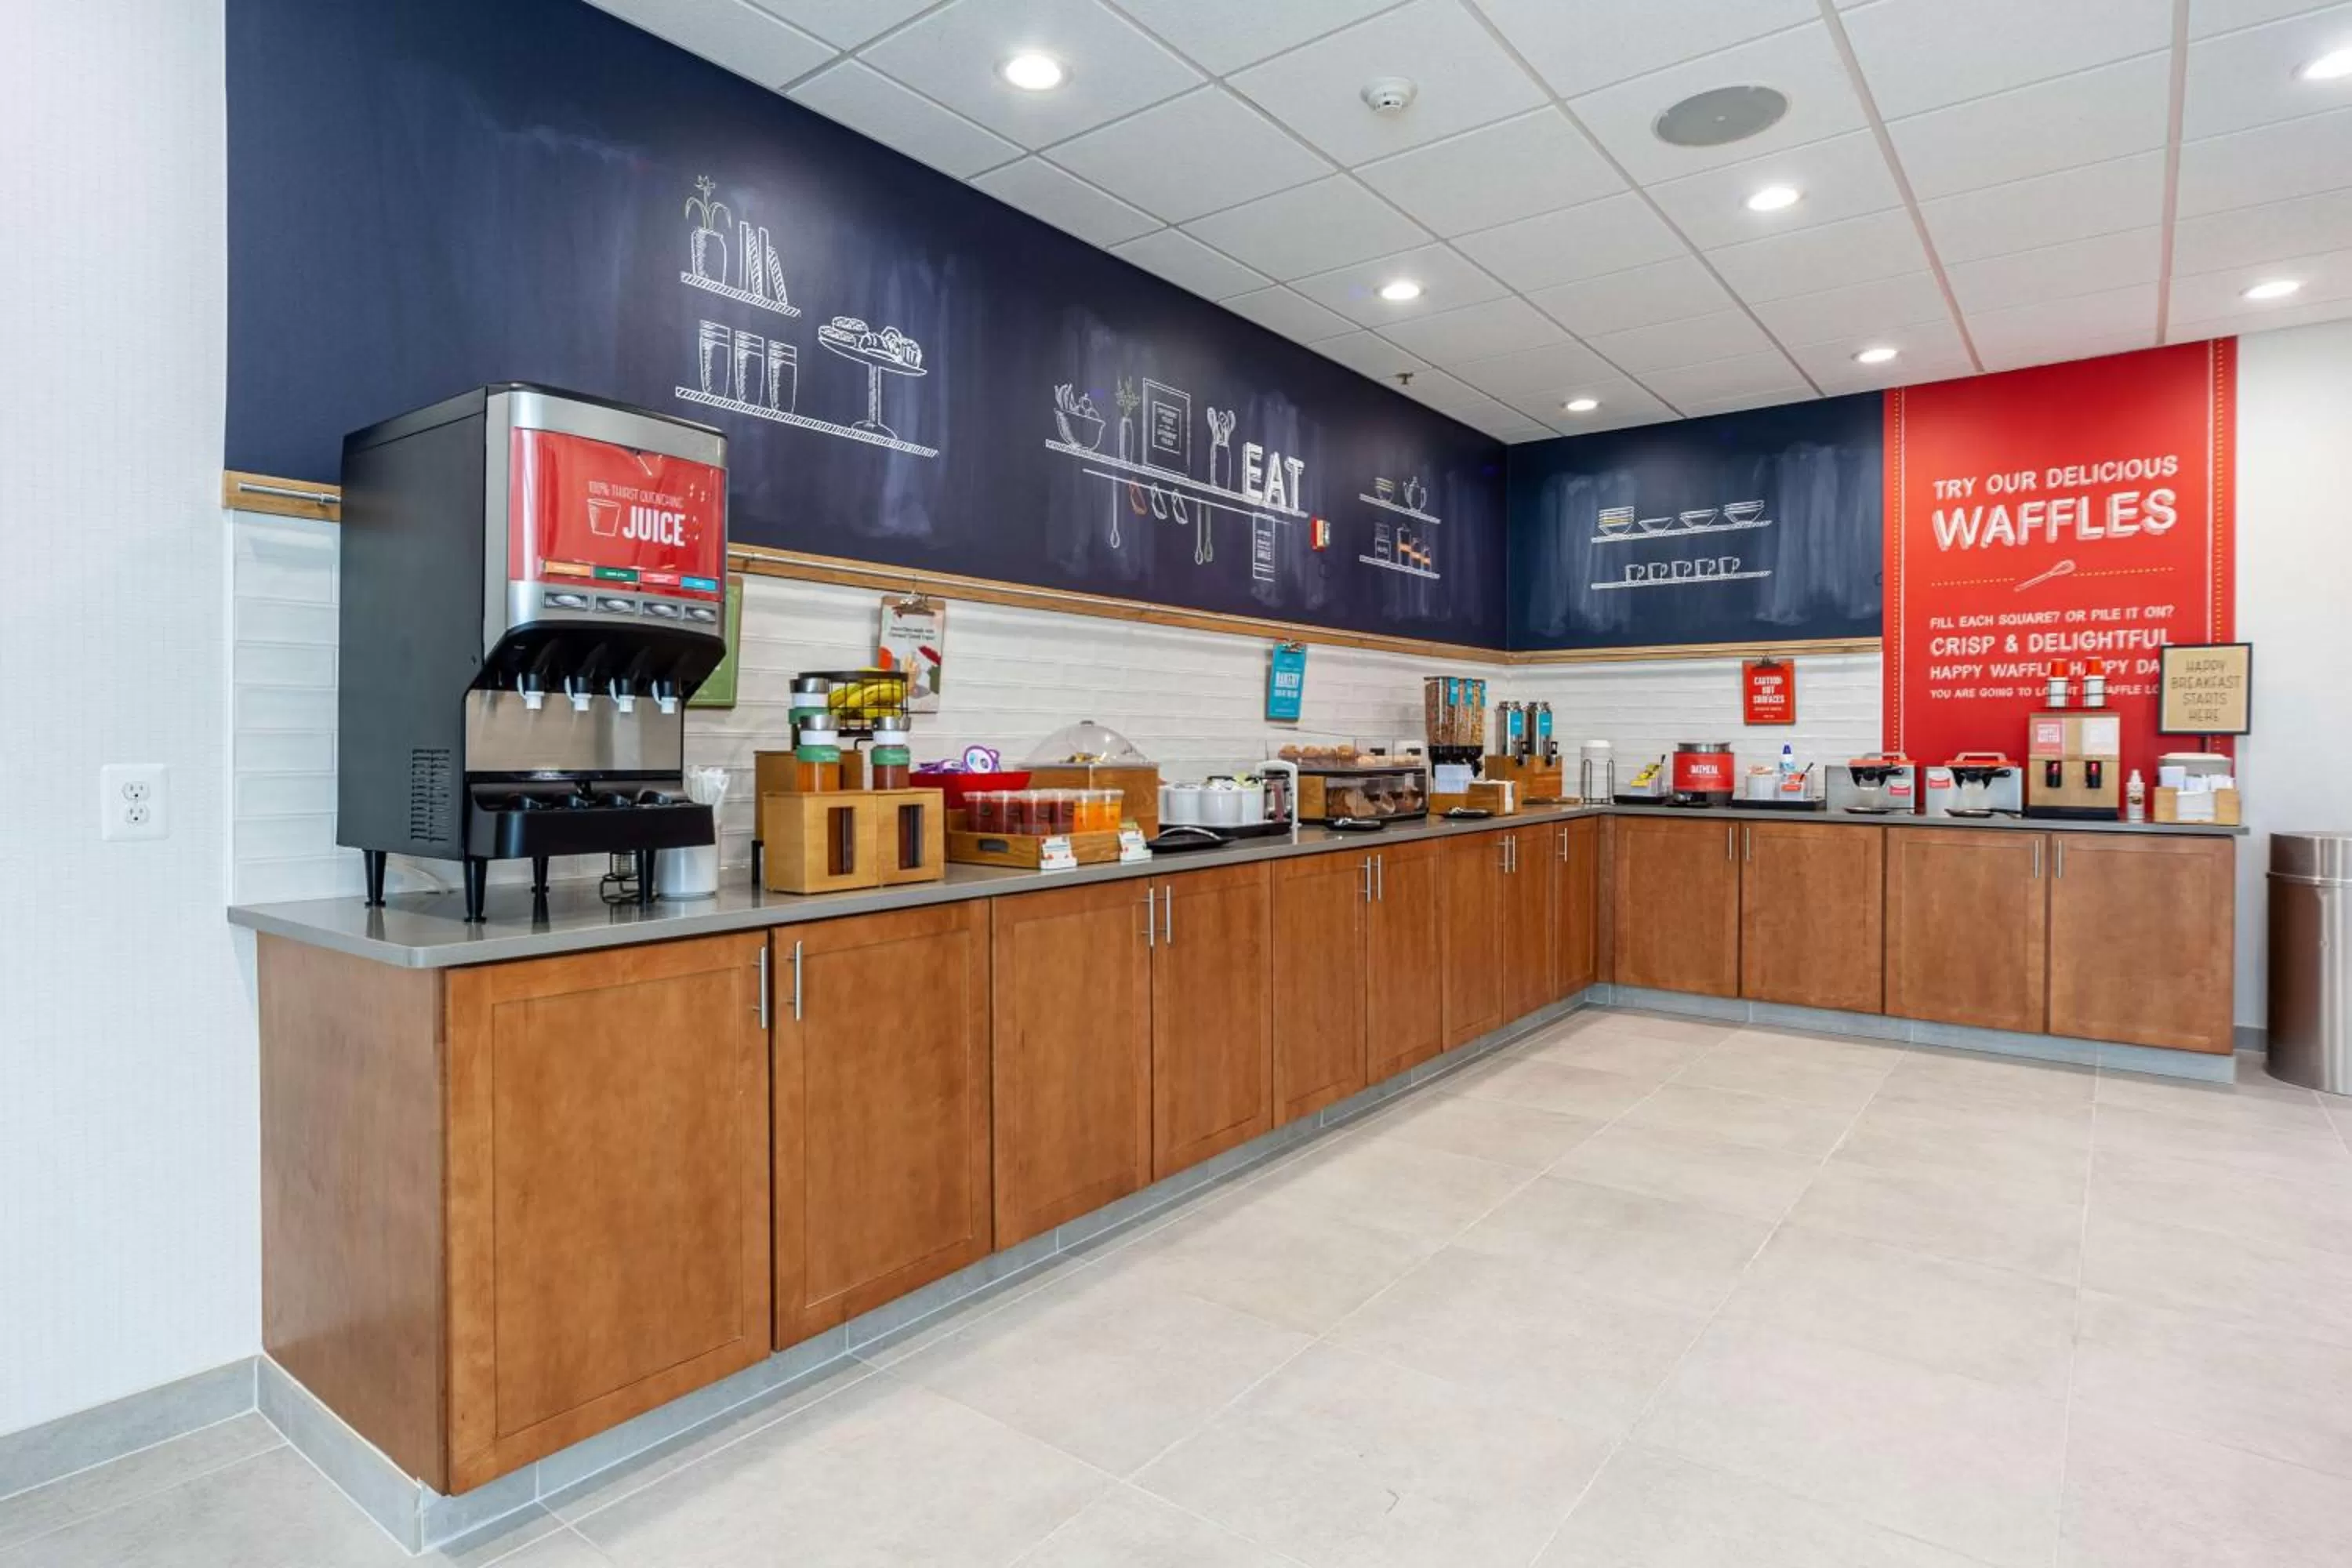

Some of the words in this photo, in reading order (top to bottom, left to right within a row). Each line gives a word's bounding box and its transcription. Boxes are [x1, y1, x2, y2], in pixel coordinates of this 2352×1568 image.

[1242, 441, 1305, 511] EAT
[1933, 477, 1977, 499] TRY
[1985, 470, 2037, 495] OUR
[2045, 455, 2178, 489] DELICIOUS
[622, 506, 686, 546] JUICE
[1931, 488, 2177, 551] WAFFLES
[1929, 617, 1955, 629] FILL
[1959, 614, 1994, 627] EACH
[1999, 611, 2060, 625] SQUARE?
[2064, 609, 2086, 622] OR
[2091, 608, 2121, 620] PILE
[2125, 607, 2140, 619] IT
[2143, 604, 2175, 619] ON?
[1929, 635, 1995, 657] CRISP
[2004, 633, 2019, 653] &
[2027, 628, 2175, 653] DELIGHTFUL
[1929, 664, 1983, 681] HAPPY
[2069, 659, 2129, 675] HPY
[2136, 658, 2160, 674] DA
[2185, 659, 2226, 673] HAPPY
[1929, 688, 1951, 699] YOU
[1955, 688, 1976, 698] ARE
[1980, 687, 2013, 697] GOING
[2017, 687, 2032, 696] TO
[2171, 675, 2241, 689] BREAKFAST
[2183, 692, 2227, 705] STARTS
[2188, 708, 2220, 721] HERE
[1690, 764, 1718, 775] OATMEAL
